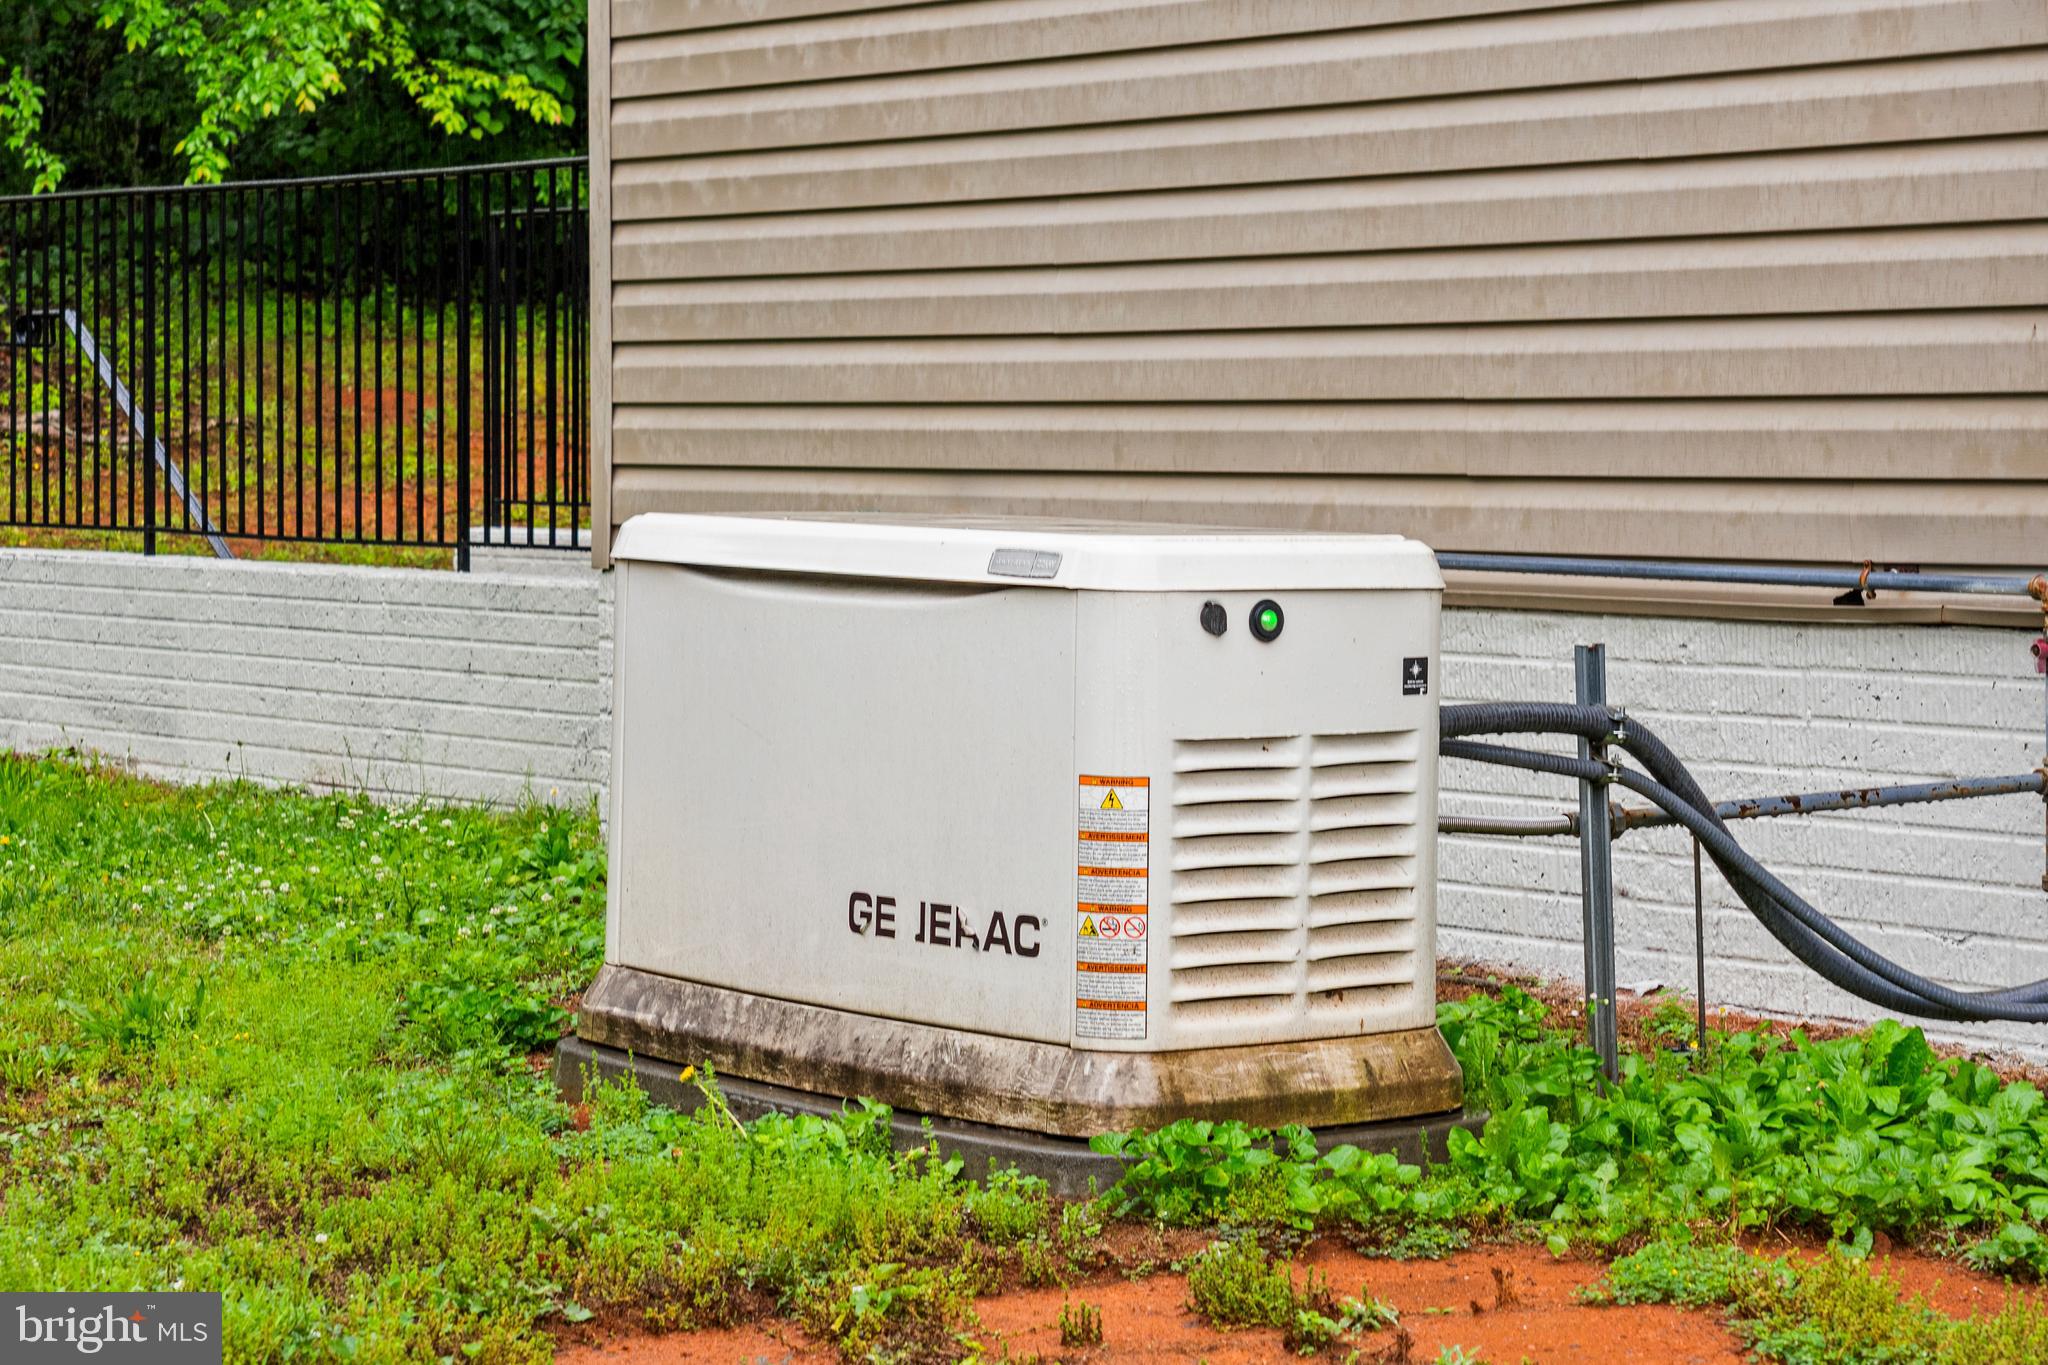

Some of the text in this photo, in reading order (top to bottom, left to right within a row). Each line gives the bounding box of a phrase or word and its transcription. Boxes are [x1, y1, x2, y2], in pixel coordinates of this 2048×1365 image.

[1099, 777, 1134, 786] WARNING
[1087, 832, 1146, 841] AVERTISSEMENT
[1090, 868, 1141, 877] ADVERTENCIA
[1098, 905, 1132, 913] WARNING
[1086, 964, 1144, 973] AVERTISSEMENT
[1089, 1001, 1139, 1010] ADVERTENCIA
